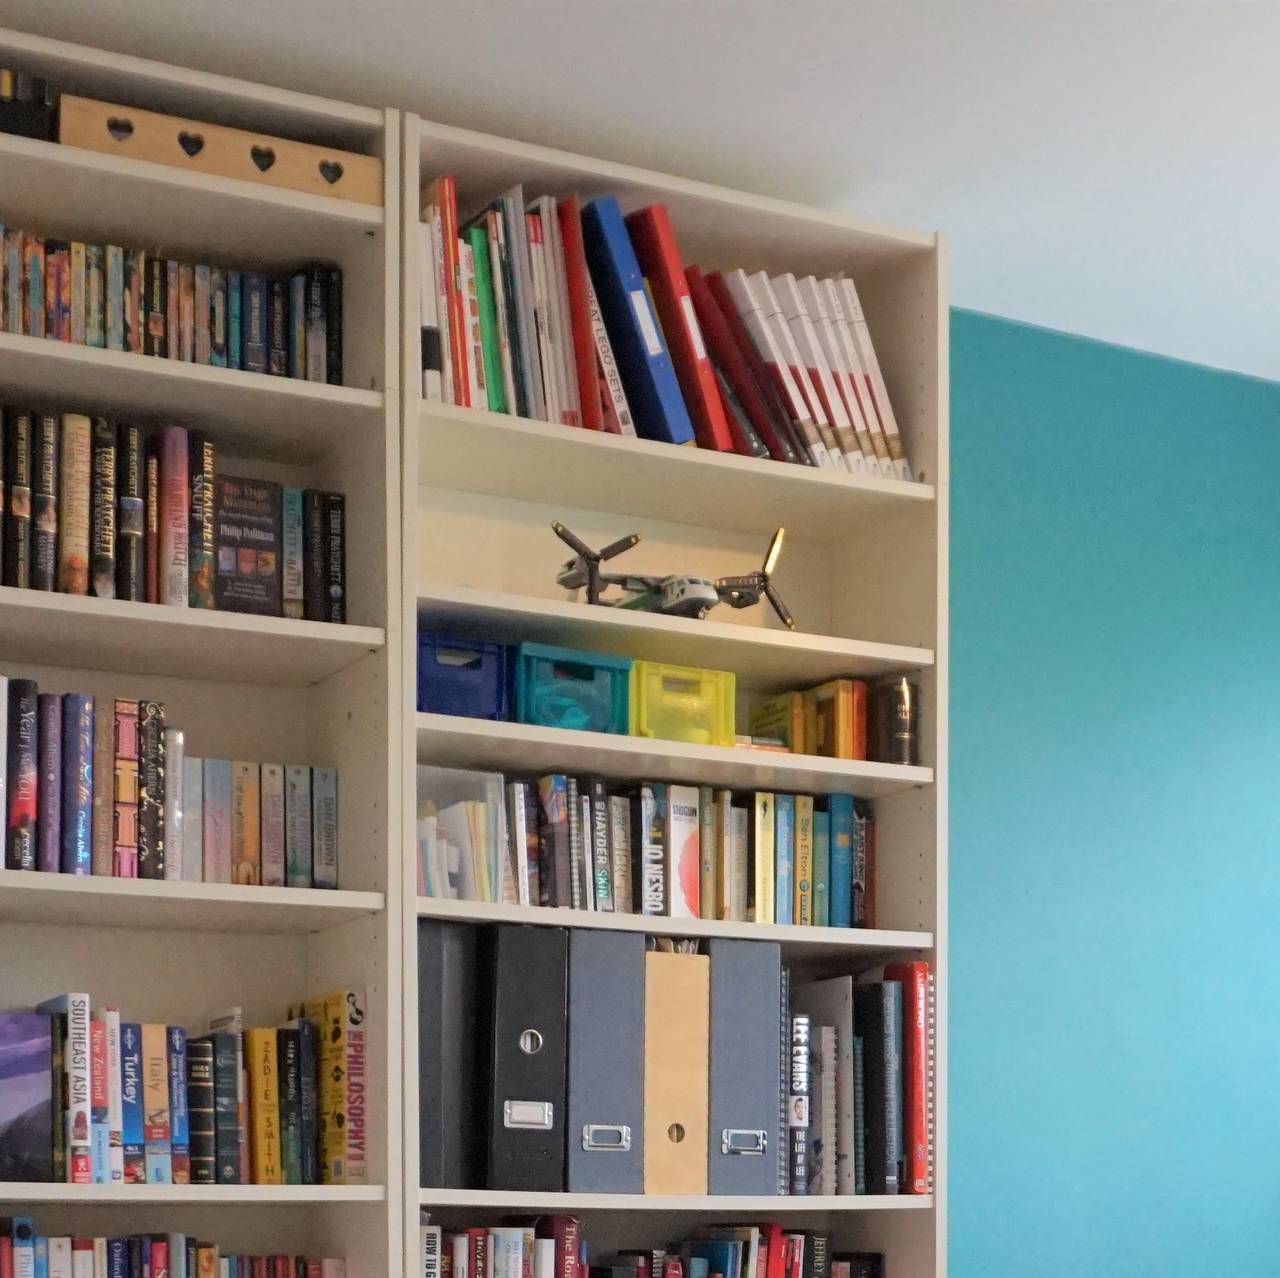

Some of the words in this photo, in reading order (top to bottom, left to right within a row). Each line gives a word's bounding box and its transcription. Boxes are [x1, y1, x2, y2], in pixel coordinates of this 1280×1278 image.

[594, 328, 612, 365] LEGO
[102, 446, 114, 485] TERRY
[203, 441, 214, 478] TERRY
[192, 474, 203, 521] SNUFF
[102, 487, 114, 560] PRATCHETT
[203, 482, 214, 555] PRATCHETT
[19, 711, 34, 742] Year
[325, 823, 334, 866] BROWN
[595, 811, 607, 864] HAYDER
[644, 842, 663, 860] JO
[596, 869, 609, 898] SKIN
[72, 1000, 87, 1072] SOUTHEAST
[93, 1030, 103, 1053] New
[792, 1017, 810, 1042] LEE
[94, 1057, 104, 1100] Zealand
[123, 1054, 138, 1104] Turkey
[148, 1057, 164, 1092] Italy
[792, 1045, 810, 1092] EVANS
[73, 1075, 87, 1104] ASIA
[348, 1043, 365, 1151] PHILOSOPHY
[425, 1233, 438, 1256] HOW
[475, 1237, 484, 1263] LOVE
[564, 1224, 575, 1252] The
[813, 1236, 828, 1273] JEFFREY
[112, 1242, 123, 1278] Oxford
[425, 1258, 437, 1270] TO
